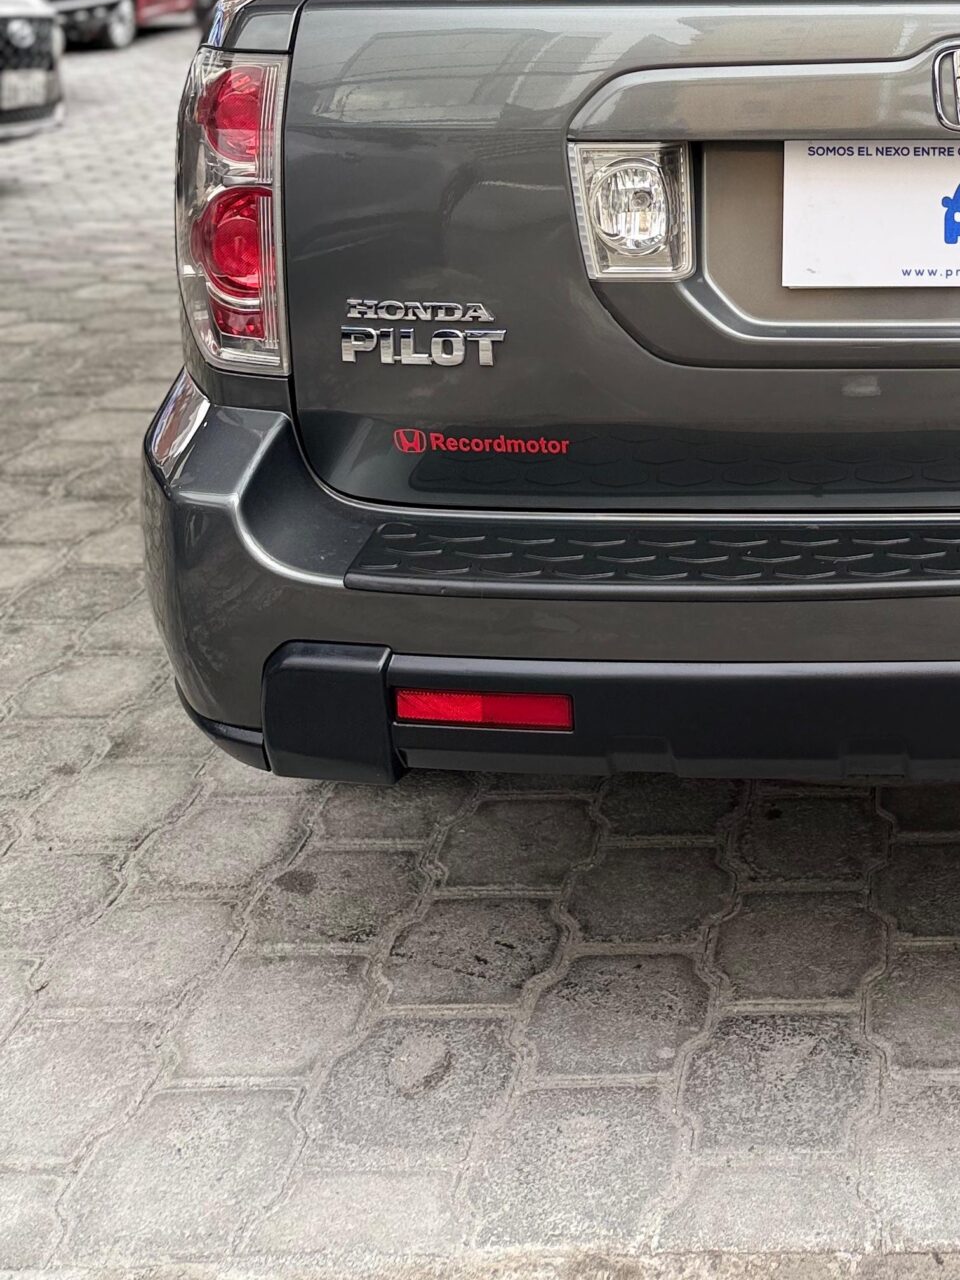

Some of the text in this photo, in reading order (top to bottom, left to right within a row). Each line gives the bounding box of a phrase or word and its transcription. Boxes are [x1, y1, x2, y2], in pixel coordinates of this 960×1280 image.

[807, 146, 854, 158] SOMOS
[857, 146, 873, 158] EL
[875, 146, 910, 158] NEXO
[913, 146, 955, 158] ENTRE
[346, 299, 494, 322] HONDA
[341, 326, 507, 366] PILOT
[429, 433, 569, 455] Recordmotor
